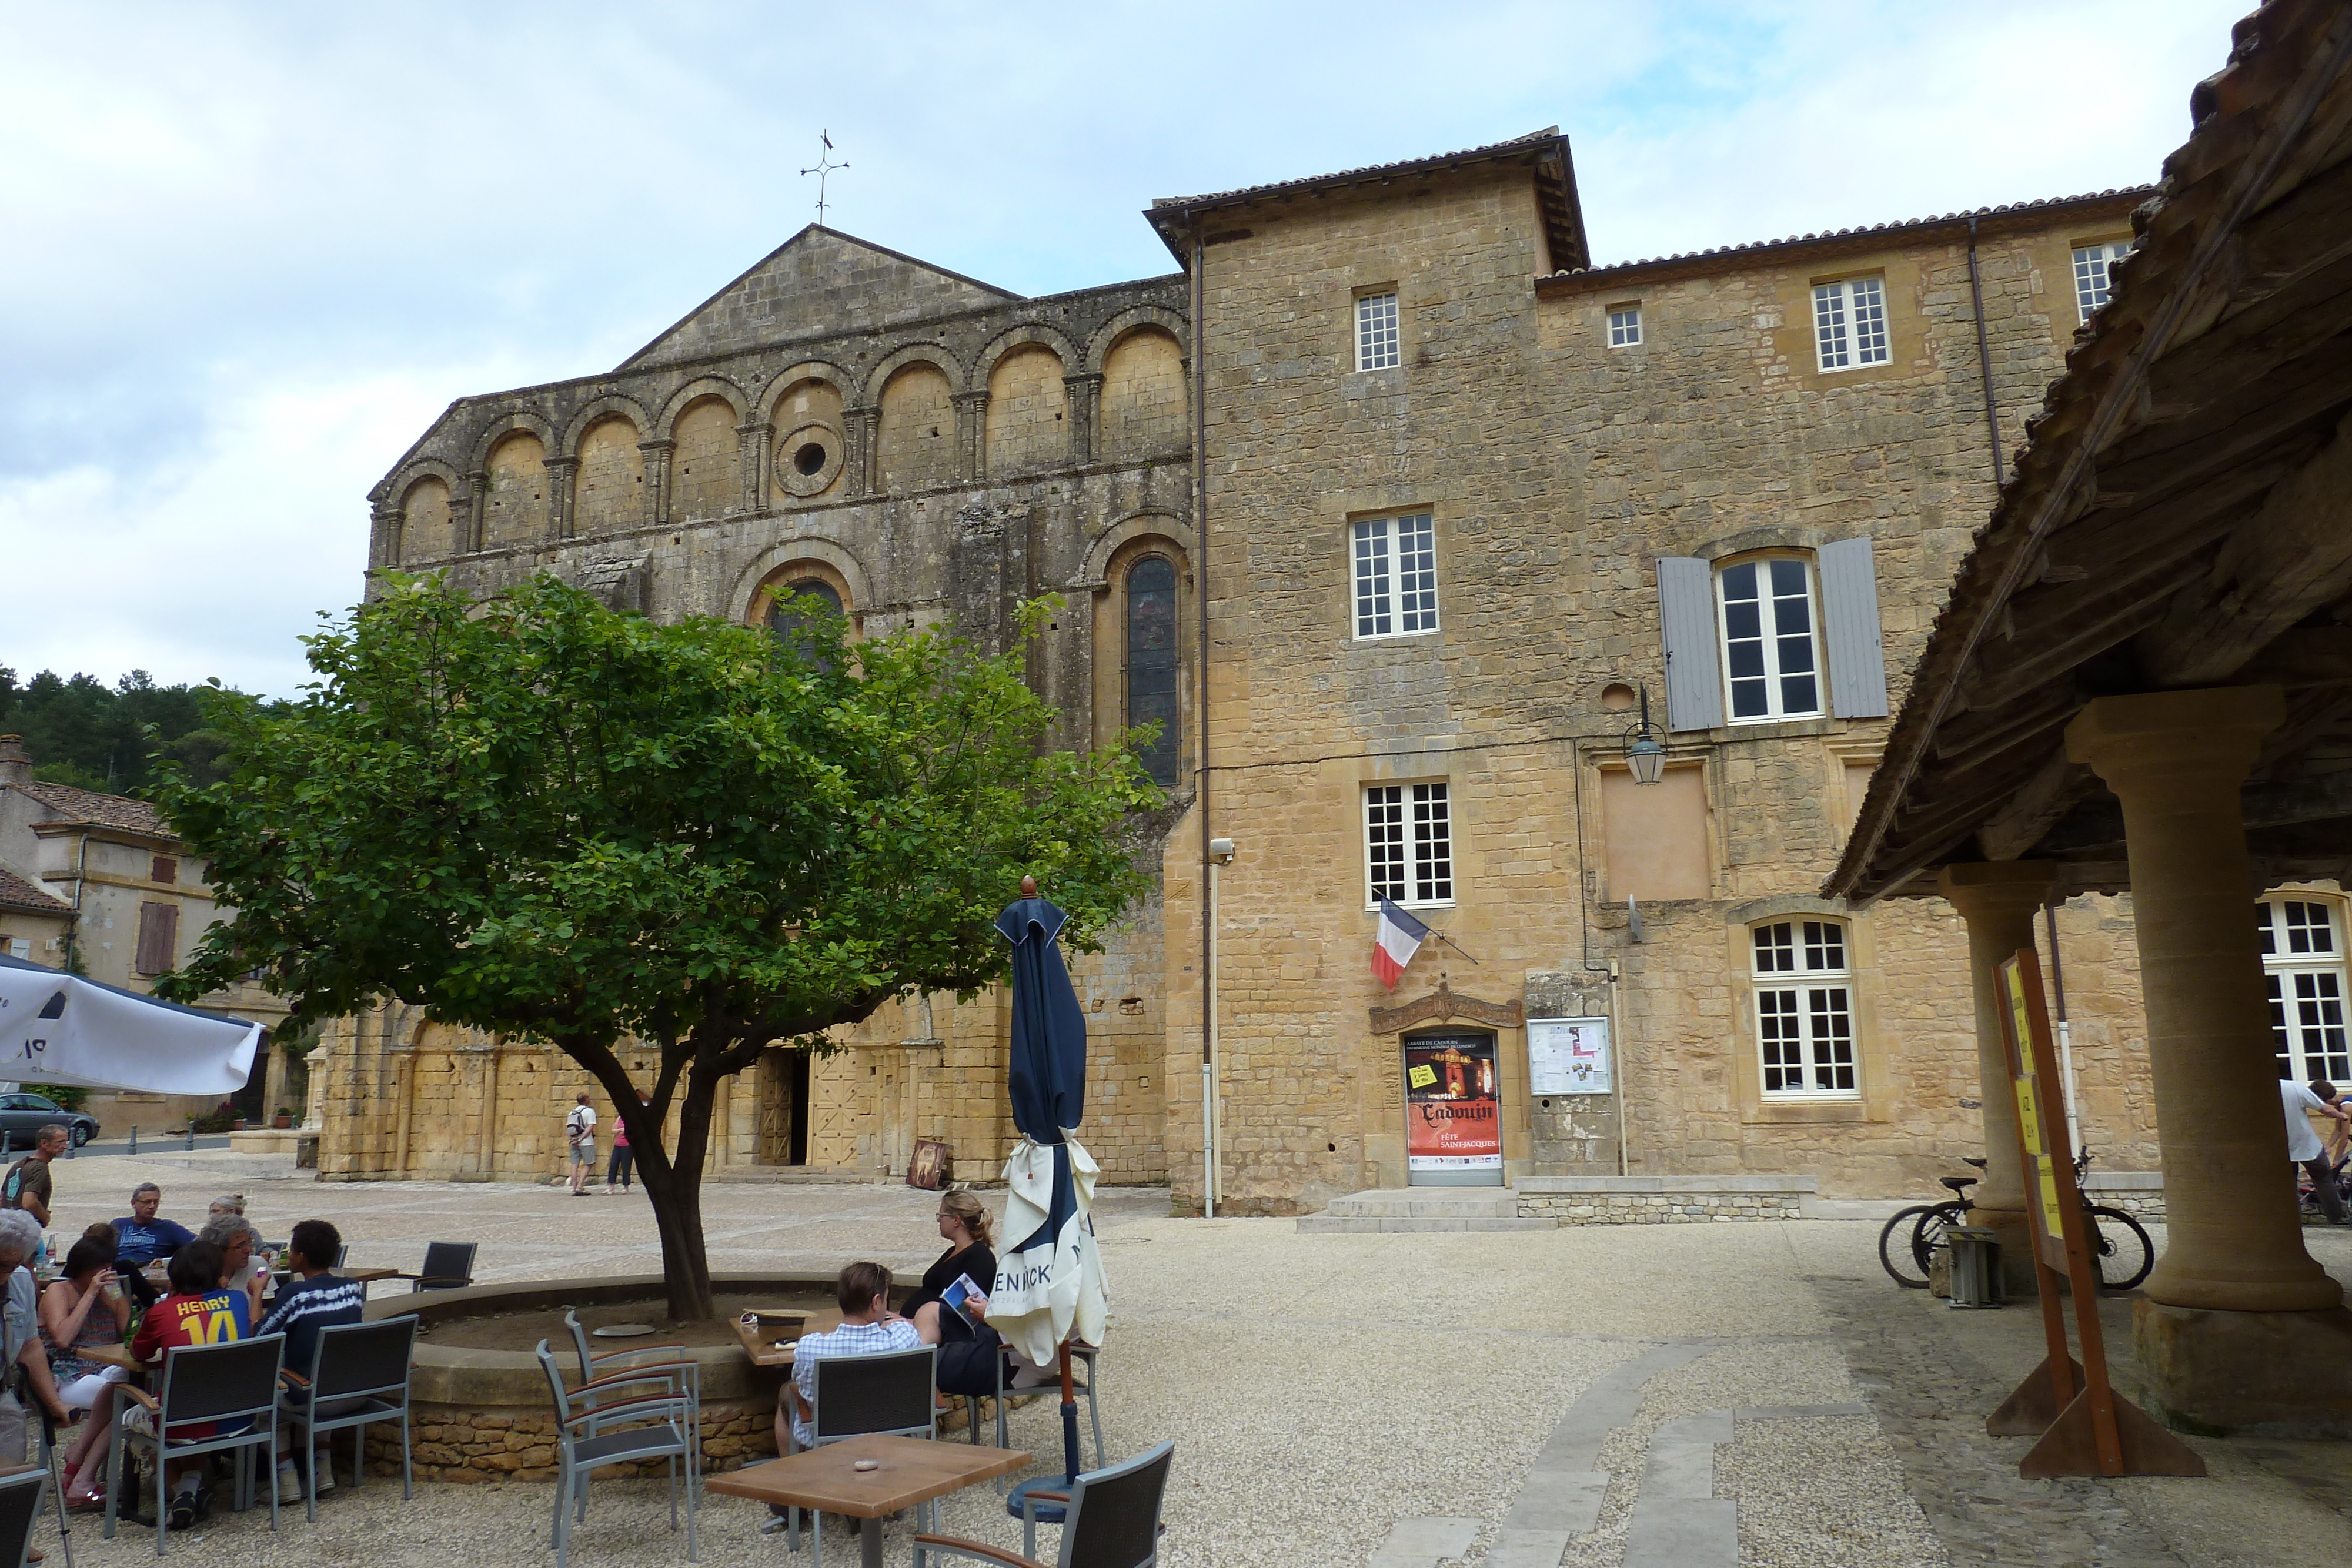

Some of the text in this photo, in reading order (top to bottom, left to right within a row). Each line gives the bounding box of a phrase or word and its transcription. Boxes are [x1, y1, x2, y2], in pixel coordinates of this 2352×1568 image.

[1422, 1103, 1494, 1127] Cadouin
[1441, 1132, 1459, 1141] FÊTE
[1441, 1140, 1496, 1148] SAINT-JACQUES
[176, 1295, 230, 1316] HENRY
